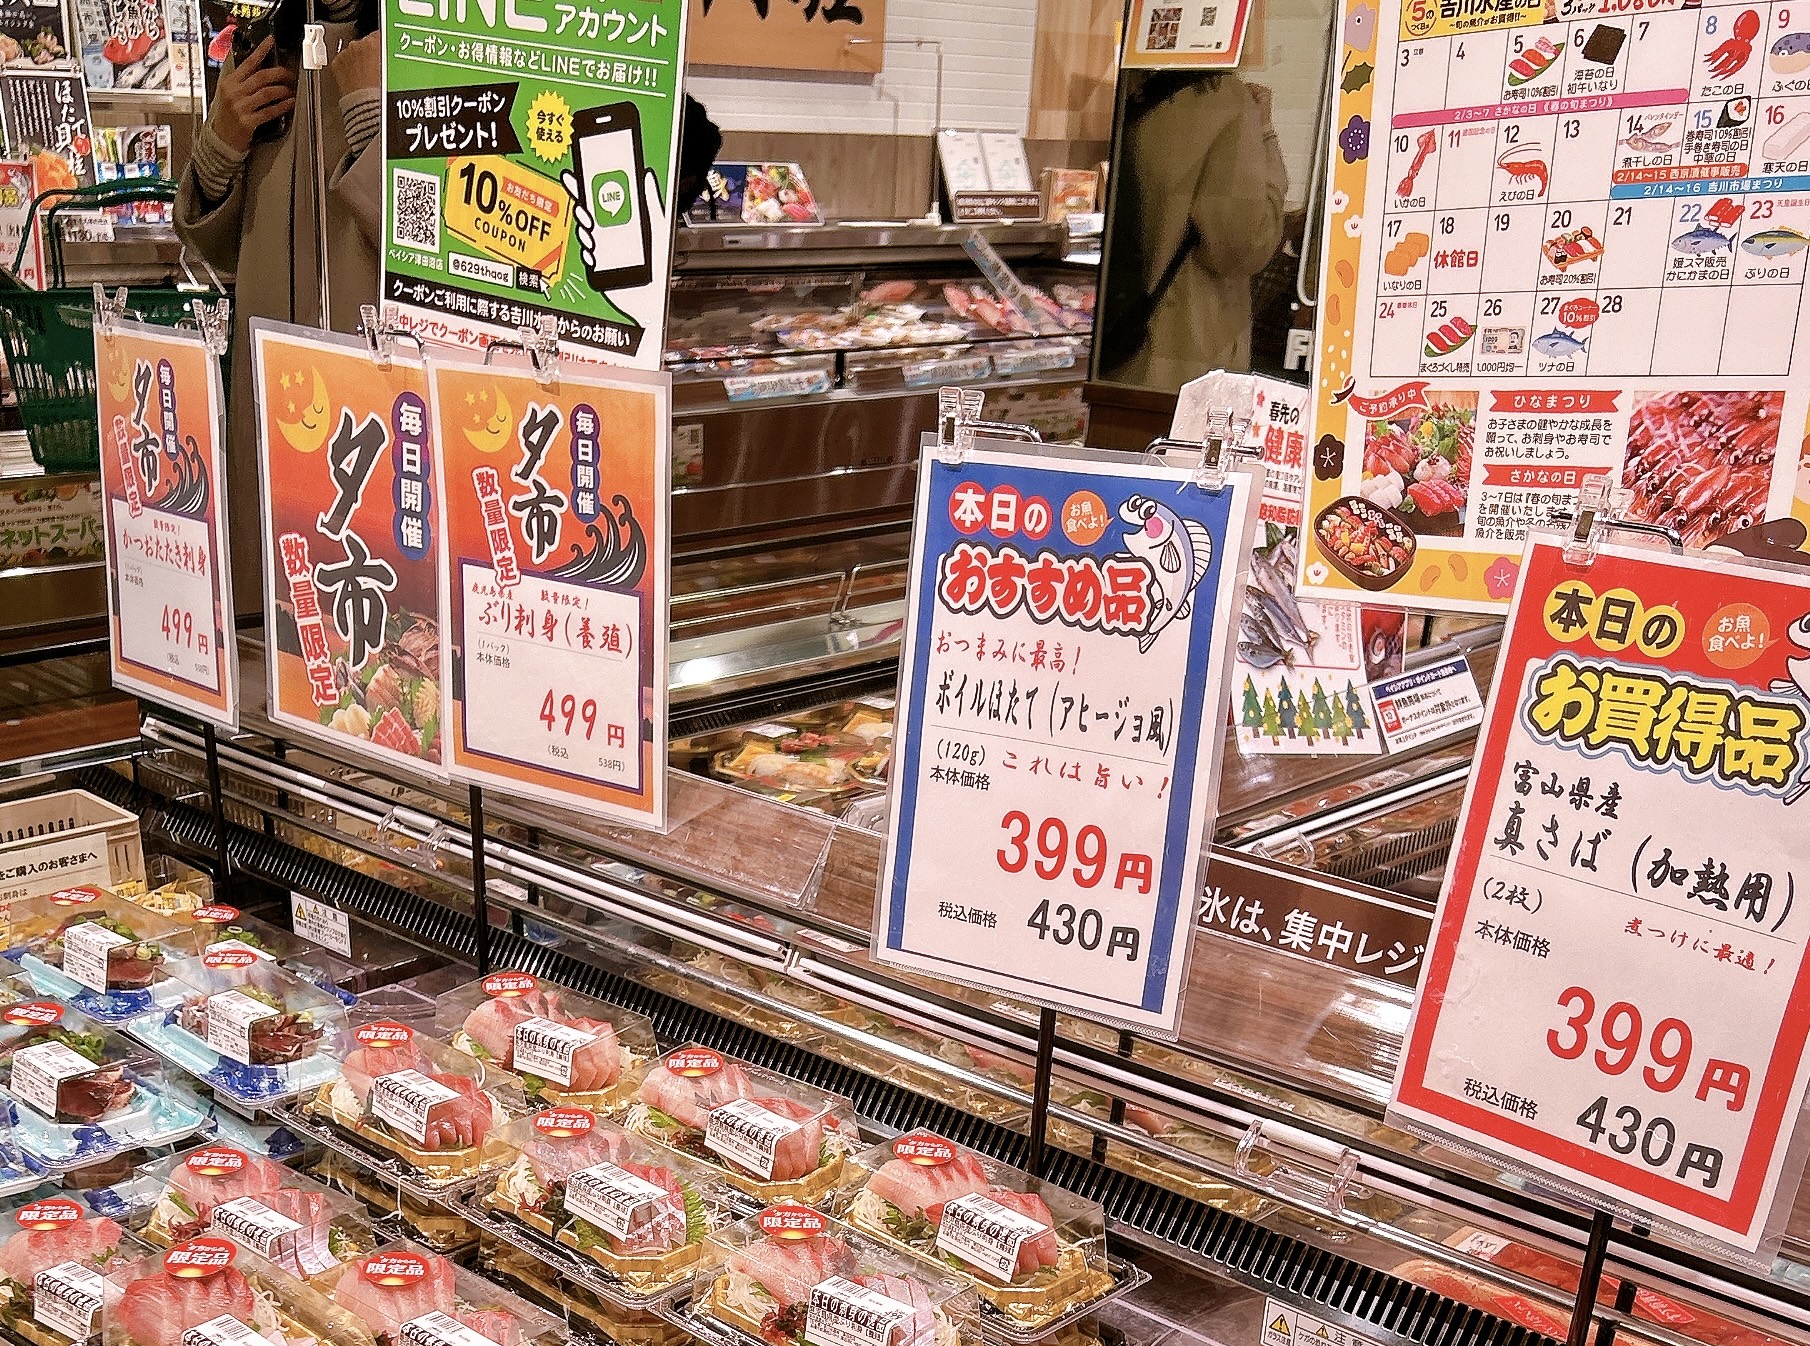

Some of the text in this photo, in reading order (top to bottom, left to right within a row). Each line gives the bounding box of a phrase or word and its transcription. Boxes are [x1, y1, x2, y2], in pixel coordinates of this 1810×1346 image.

[555, 3, 668, 48] アカウント
[1705, 15, 1718, 35] 8
[1778, 9, 1791, 29] 9
[1574, 29, 1584, 47] 6
[1638, 21, 1650, 41] 7
[1456, 42, 1466, 60] 4
[1513, 35, 1524, 53] 5
[399, 32, 658, 88] クーポン・お得情報などLINEでお届け!!
[1401, 49, 1410, 67] 3
[1573, 69, 1615, 81] 海苔の日
[1567, 79, 1618, 94] 初午いなり
[1701, 83, 1745, 97] たこの日
[397, 92, 506, 120] 10%割引クーポン
[1494, 104, 1537, 117] さかなの日
[1765, 105, 1785, 125] 16
[537, 111, 565, 127] 今すぐ
[1627, 115, 1644, 133] 14
[1693, 109, 1713, 129] 15
[405, 121, 498, 153] プレゼント!
[536, 127, 564, 144] 使える
[1447, 129, 1461, 148] 11
[1504, 125, 1520, 144] 12
[1563, 119, 1581, 139] 13
[1394, 135, 1409, 153] 10
[1684, 140, 1749, 154] 手巻き寿司の日
[1622, 155, 1673, 168] 煮干しの日
[1693, 151, 1737, 163] 中華の日
[1762, 160, 1809, 174] 寒天の日
[1708, 178, 1783, 193] 吉川市場まつり
[505, 182, 554, 213] お友だち限定
[602, 190, 621, 203] LINE
[1394, 197, 1426, 209] いかの日
[1500, 189, 1535, 202] えびの日
[1551, 209, 1573, 229] 20
[1612, 206, 1633, 226] 21
[1679, 204, 1703, 223] 22
[1750, 200, 1774, 220] 23
[1387, 219, 1402, 238] 17
[1439, 218, 1455, 236] 18
[1494, 213, 1510, 232] 19
[474, 217, 527, 253] COUPON
[1433, 249, 1479, 270] 休館日
[518, 271, 541, 289] 検索
[1666, 268, 1730, 282] かにかまの日
[1744, 267, 1790, 279] ぶりの日
[1383, 280, 1422, 291] いなりの日
[393, 279, 631, 348] クーポンご利用に際する吉川水からのお願い
[1378, 302, 1395, 319] 24
[1430, 300, 1447, 318] 25
[1483, 298, 1502, 317] 26
[1540, 297, 1560, 315] 27
[1601, 295, 1623, 314] 28
[1538, 362, 1575, 373] ツナの日
[1357, 389, 1418, 417] ご予約承り中
[1513, 394, 1591, 408] ひなまつり
[133, 364, 162, 494] 夕市
[1487, 418, 1613, 431] お子さまの健やかな成長を
[1485, 431, 1612, 446] 願って、お刺身やお寿司で
[1484, 446, 1570, 460] お祝いしましょう。
[575, 411, 595, 515] 毎日開催
[399, 402, 423, 550] 毎日開催
[511, 405, 566, 560] 夕市
[1510, 469, 1577, 484] さかなの日
[953, 488, 1048, 533] 本日の
[1070, 501, 1093, 516] お魚
[475, 471, 518, 582] 数量限定
[1066, 515, 1104, 534] 食べよ!
[318, 410, 395, 664] 夕市
[945, 548, 1147, 626] おすすめ品
[282, 535, 338, 703] 数量限定
[1549, 587, 1678, 650] 本日の
[1718, 615, 1751, 633] お魚
[479, 600, 633, 659] ぶり刺身(養殖)
[1708, 632, 1766, 653] 食べよ!
[476, 652, 511, 669] 本体価格
[936, 630, 1081, 675] おつまみに最高!
[1530, 662, 1803, 785] お買得品
[937, 739, 986, 766] (120g)
[929, 766, 991, 792] 本体価格
[1002, 750, 1170, 799] これは旨い!
[1513, 760, 1623, 819] 富山県産
[996, 810, 1153, 894] 399円
[1483, 876, 1543, 914] (2枚)
[937, 899, 1141, 962] 税込価格 430円
[1199, 886, 1425, 975] 氷は、集中レジ
[1475, 919, 1552, 960] 本体価格
[1624, 916, 1776, 975] 煮つけに最適!
[1546, 985, 1752, 1113] 399円
[1463, 1077, 1725, 1189] 税込価格 430円
[762, 1214, 823, 1230] 限定品
[167, 1249, 230, 1267] 限定品
[366, 1262, 425, 1276] 限定品
